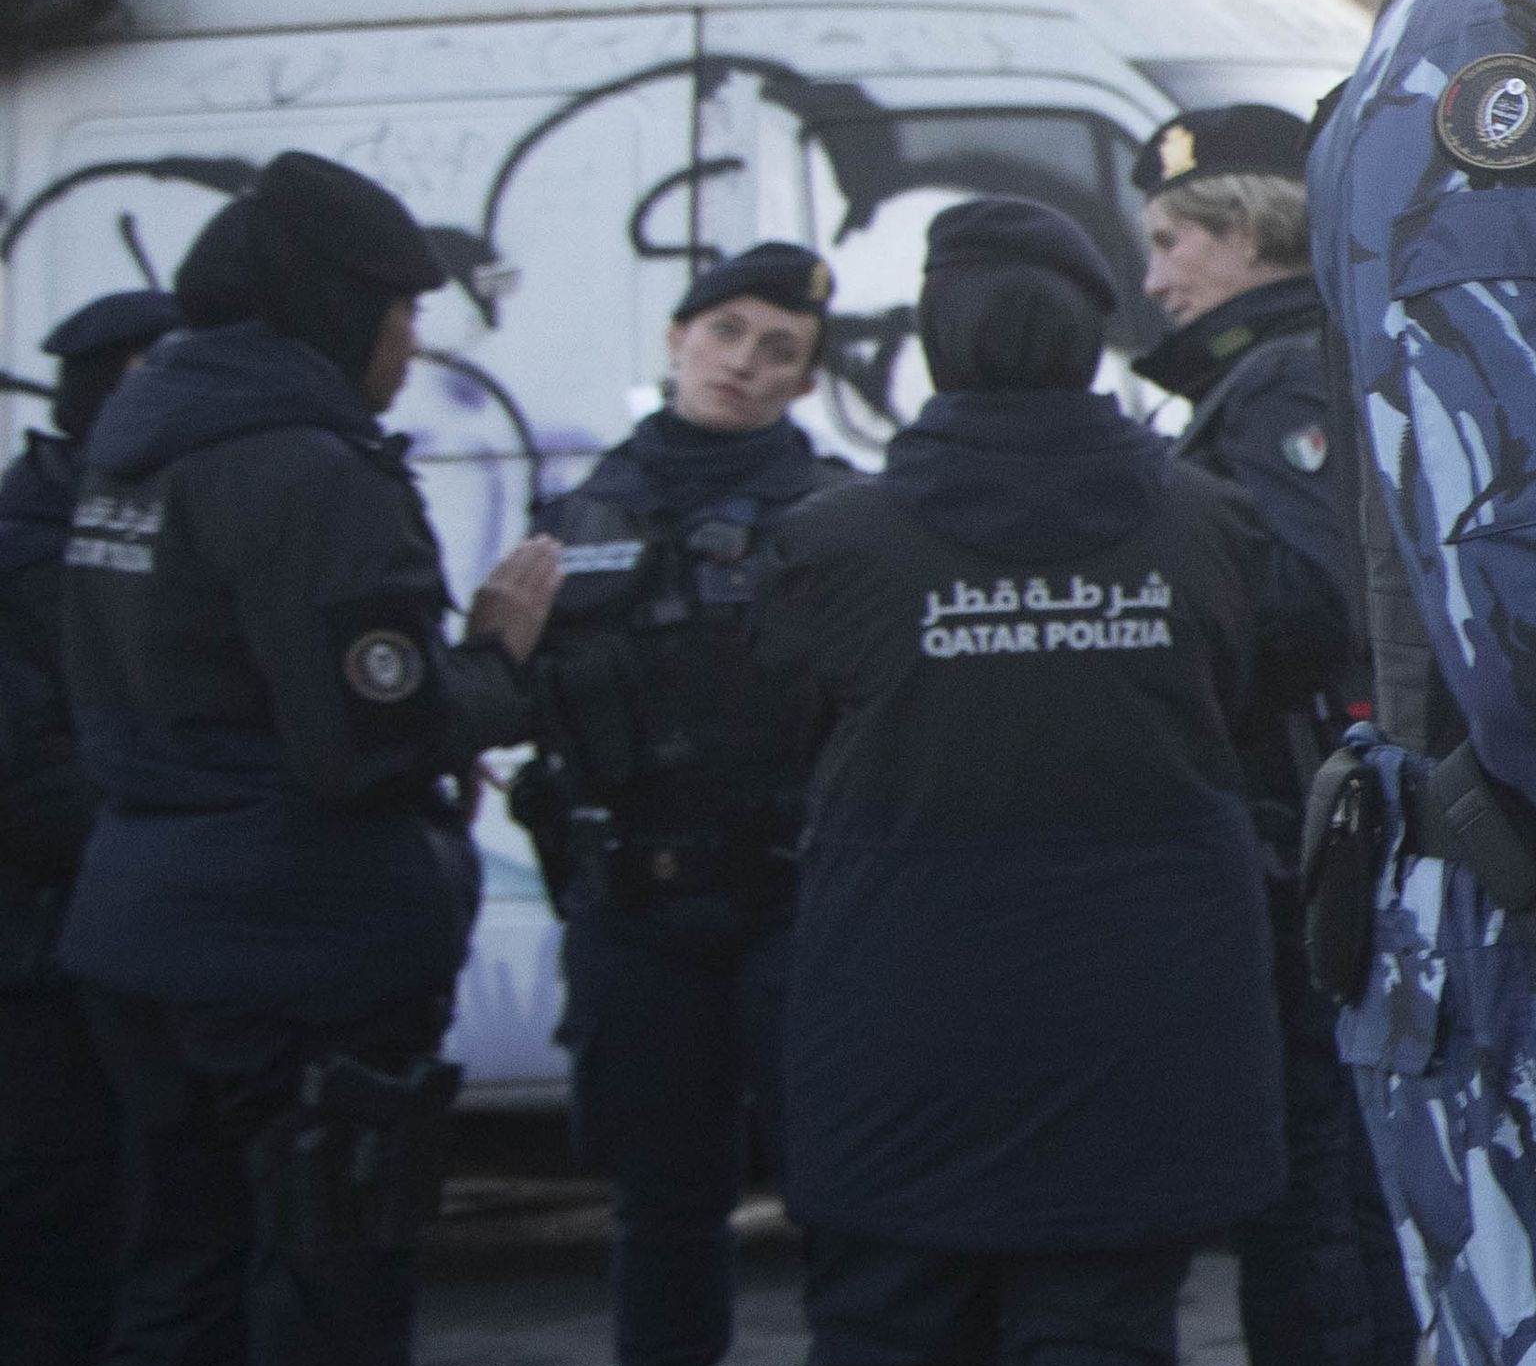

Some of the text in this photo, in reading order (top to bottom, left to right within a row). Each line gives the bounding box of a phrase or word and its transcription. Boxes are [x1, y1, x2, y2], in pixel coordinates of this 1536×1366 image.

[920, 569, 1172, 628] شرطة قطر
[920, 618, 1173, 659] QATAR POLIZIA
